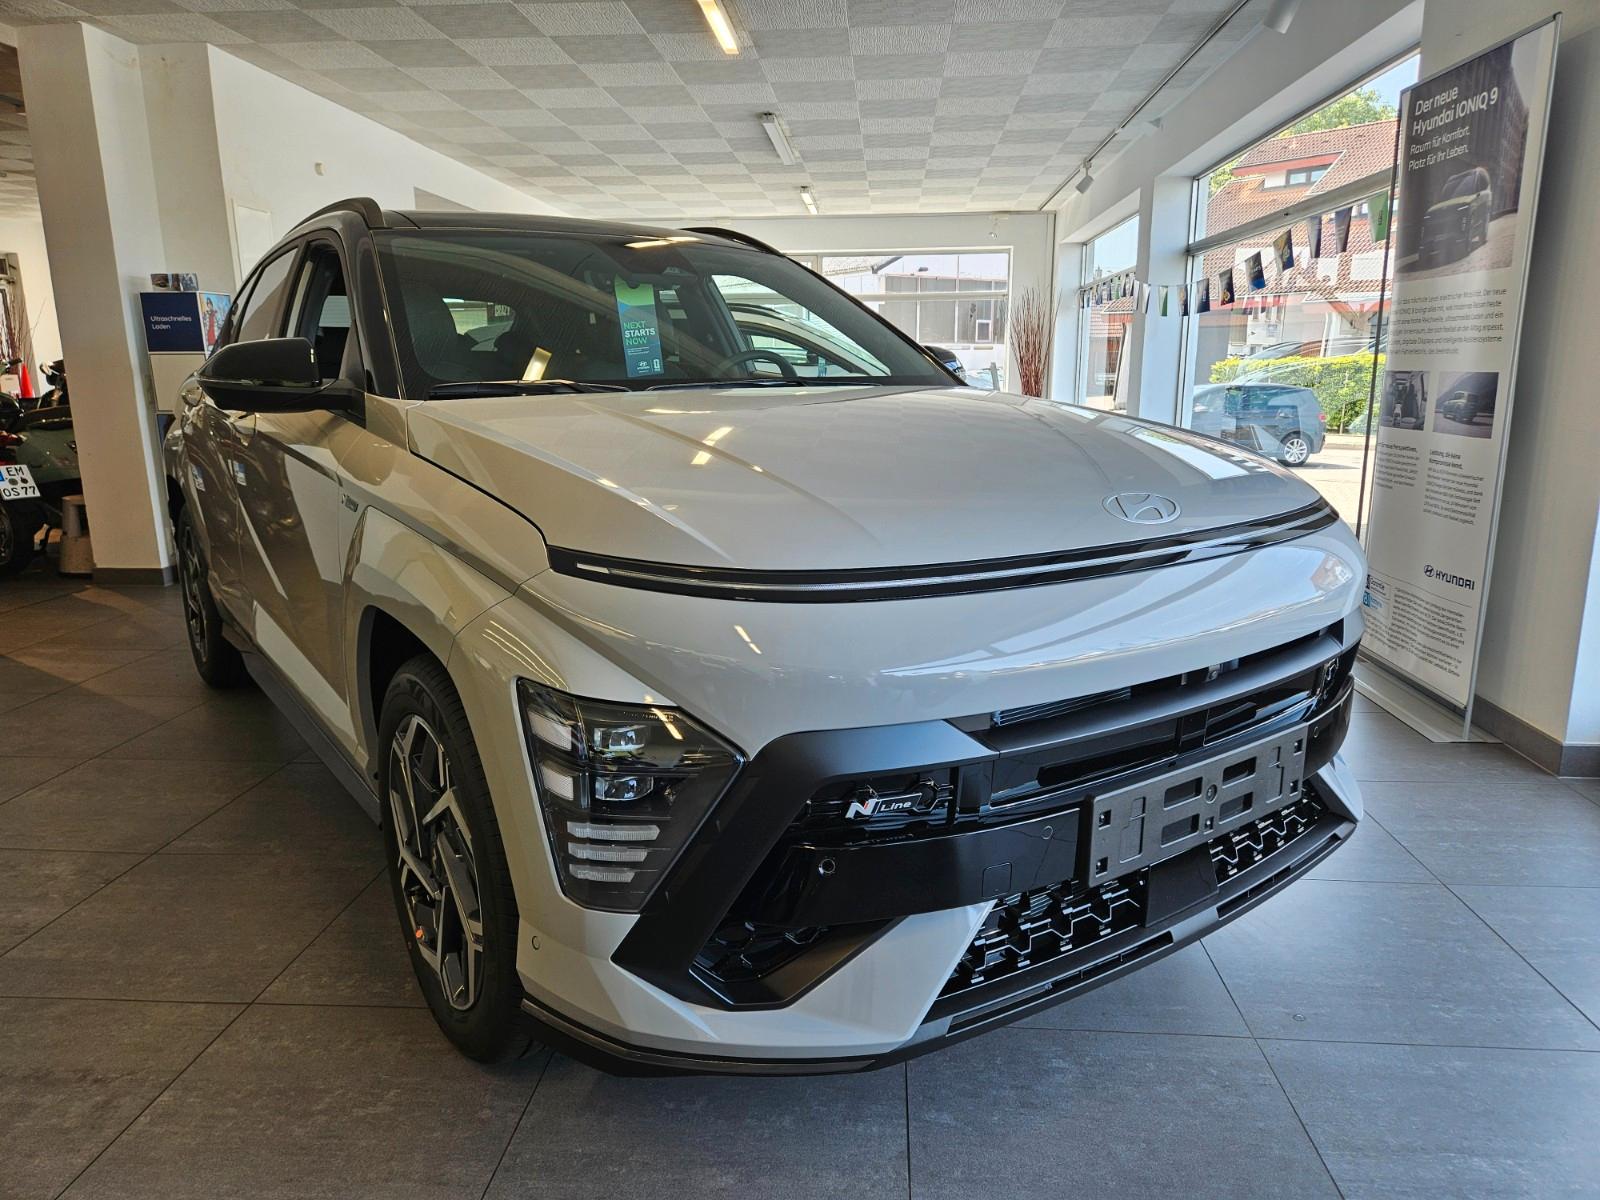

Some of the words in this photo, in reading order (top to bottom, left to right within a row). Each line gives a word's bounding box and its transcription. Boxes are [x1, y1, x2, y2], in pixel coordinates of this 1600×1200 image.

[1414, 98, 1432, 116] Der
[1434, 86, 1459, 107] neue
[1412, 106, 1454, 136] Hyundai
[1456, 91, 1488, 119] IONIQ
[1490, 86, 1499, 105] 9
[1410, 141, 1431, 155] Raum
[1432, 135, 1442, 148] für
[1408, 158, 1426, 171] Platz
[1426, 154, 1436, 166] für
[624, 320, 646, 329] NEXT
[624, 328, 656, 338] STARTS
[625, 337, 647, 346] NOW
[6, 466, 24, 476] EM
[1435, 569, 1475, 590] HYUNDAI
[845, 798, 878, 819] N
[880, 801, 912, 812] Line
